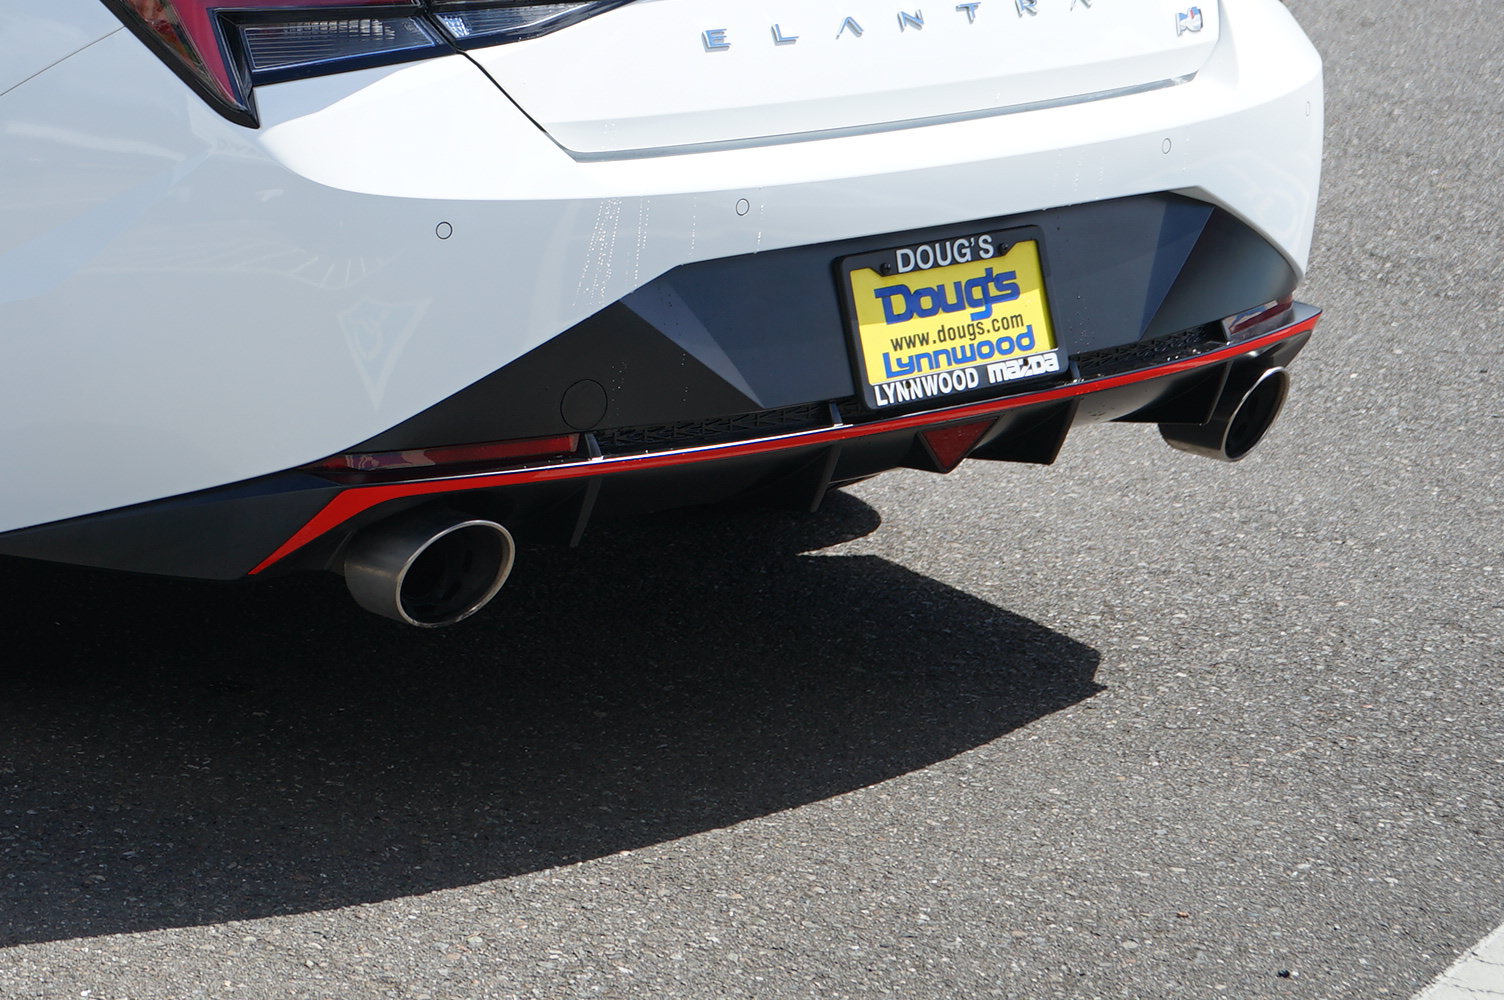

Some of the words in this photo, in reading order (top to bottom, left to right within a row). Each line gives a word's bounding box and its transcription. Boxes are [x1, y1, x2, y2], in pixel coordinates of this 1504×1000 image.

[896, 234, 995, 274] DOUG'S
[873, 266, 1021, 326] Doug's
[882, 325, 1036, 379] Lynnwood
[890, 312, 1025, 352] www.dougs.com
[874, 367, 980, 407] LYNNWOOD
